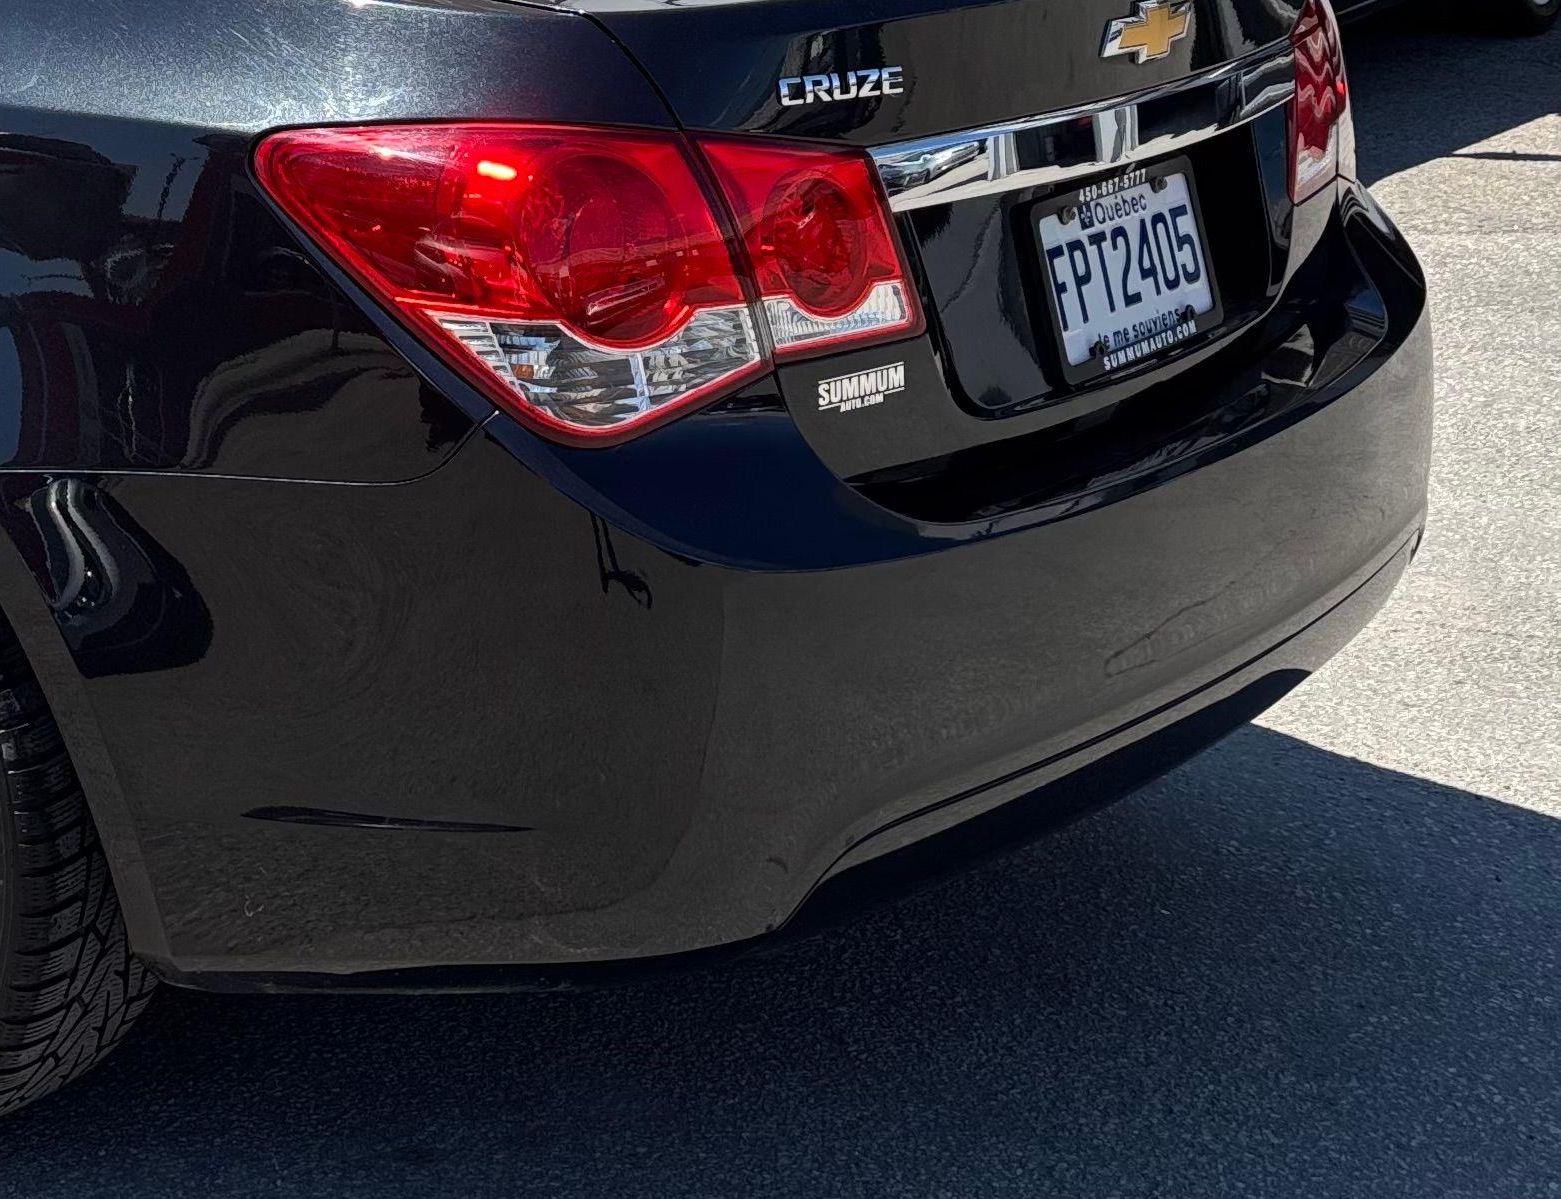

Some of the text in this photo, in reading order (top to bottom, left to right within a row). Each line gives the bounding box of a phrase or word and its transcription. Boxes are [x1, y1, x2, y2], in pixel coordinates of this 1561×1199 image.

[778, 66, 904, 106] CRUZE
[1079, 168, 1147, 203] 450-667-5777
[1095, 193, 1147, 224] Québec
[1046, 204, 1201, 332] FPT2405
[1113, 326, 1130, 343] me
[1134, 308, 1181, 339] souviens
[1104, 320, 1197, 371] SUMMUMAUTO.COM
[818, 365, 905, 406] SUMMUM
[840, 392, 884, 412] AUTO.COM
